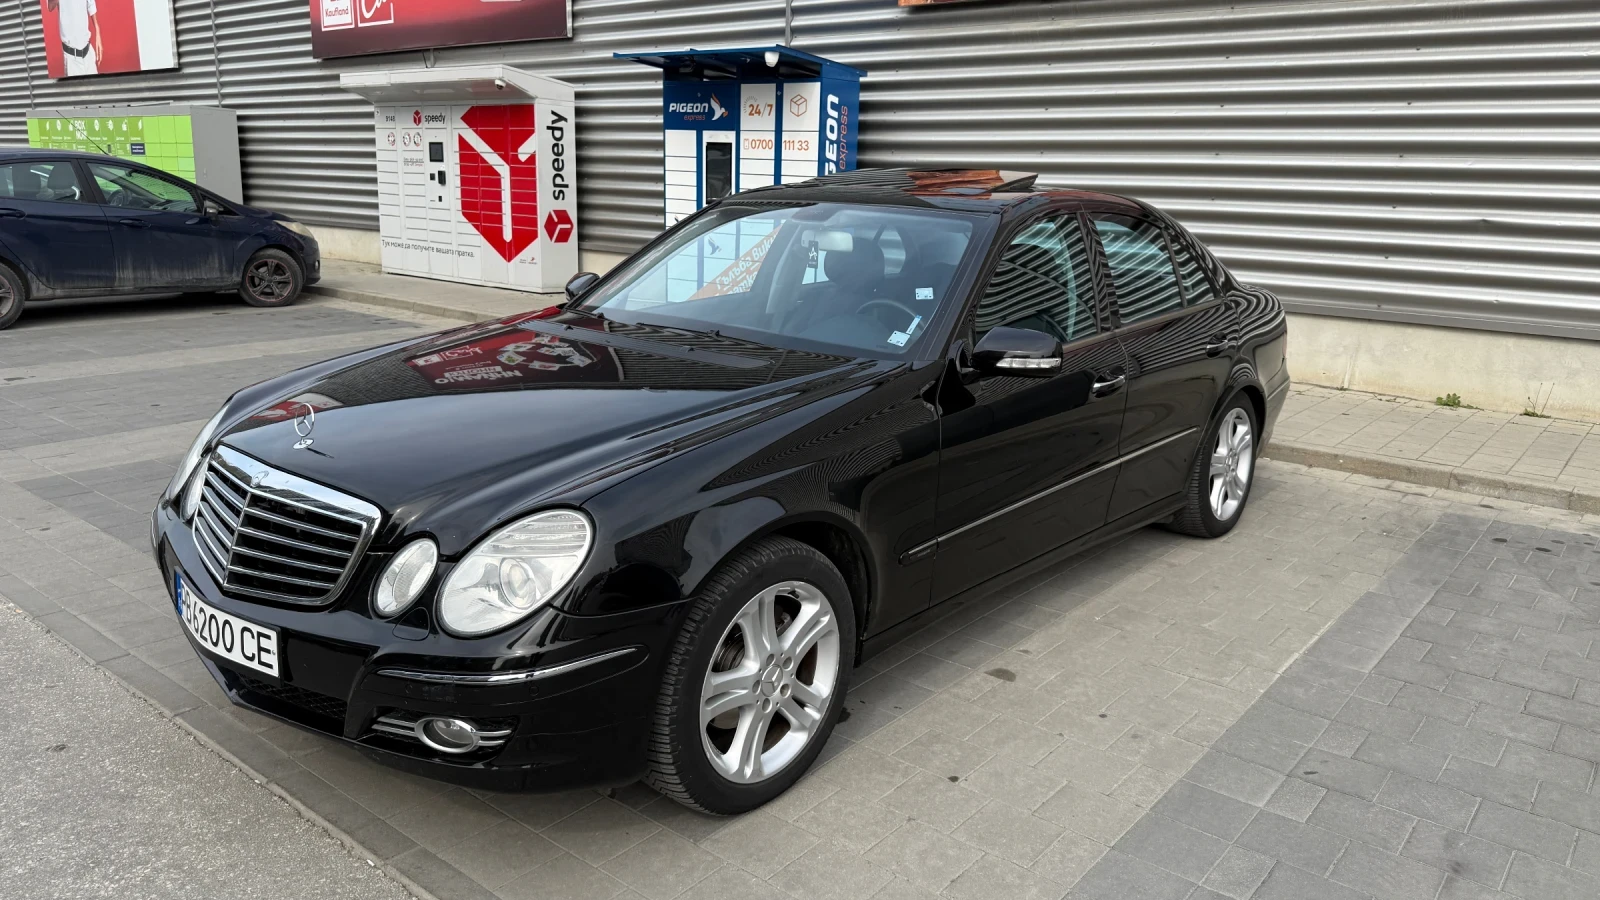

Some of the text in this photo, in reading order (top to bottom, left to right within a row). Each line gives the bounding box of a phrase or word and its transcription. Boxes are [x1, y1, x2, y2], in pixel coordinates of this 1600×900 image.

[325, 6, 349, 17] Kaufland
[669, 102, 708, 113] PIGEON
[748, 102, 773, 118] 24/7
[424, 112, 446, 124] speedy
[839, 105, 848, 170] express
[750, 139, 809, 151] 0700 111 33
[546, 110, 569, 201] speedy
[382, 239, 390, 248] Тук
[411, 244, 435, 253] получите
[240, 626, 274, 670] CE
